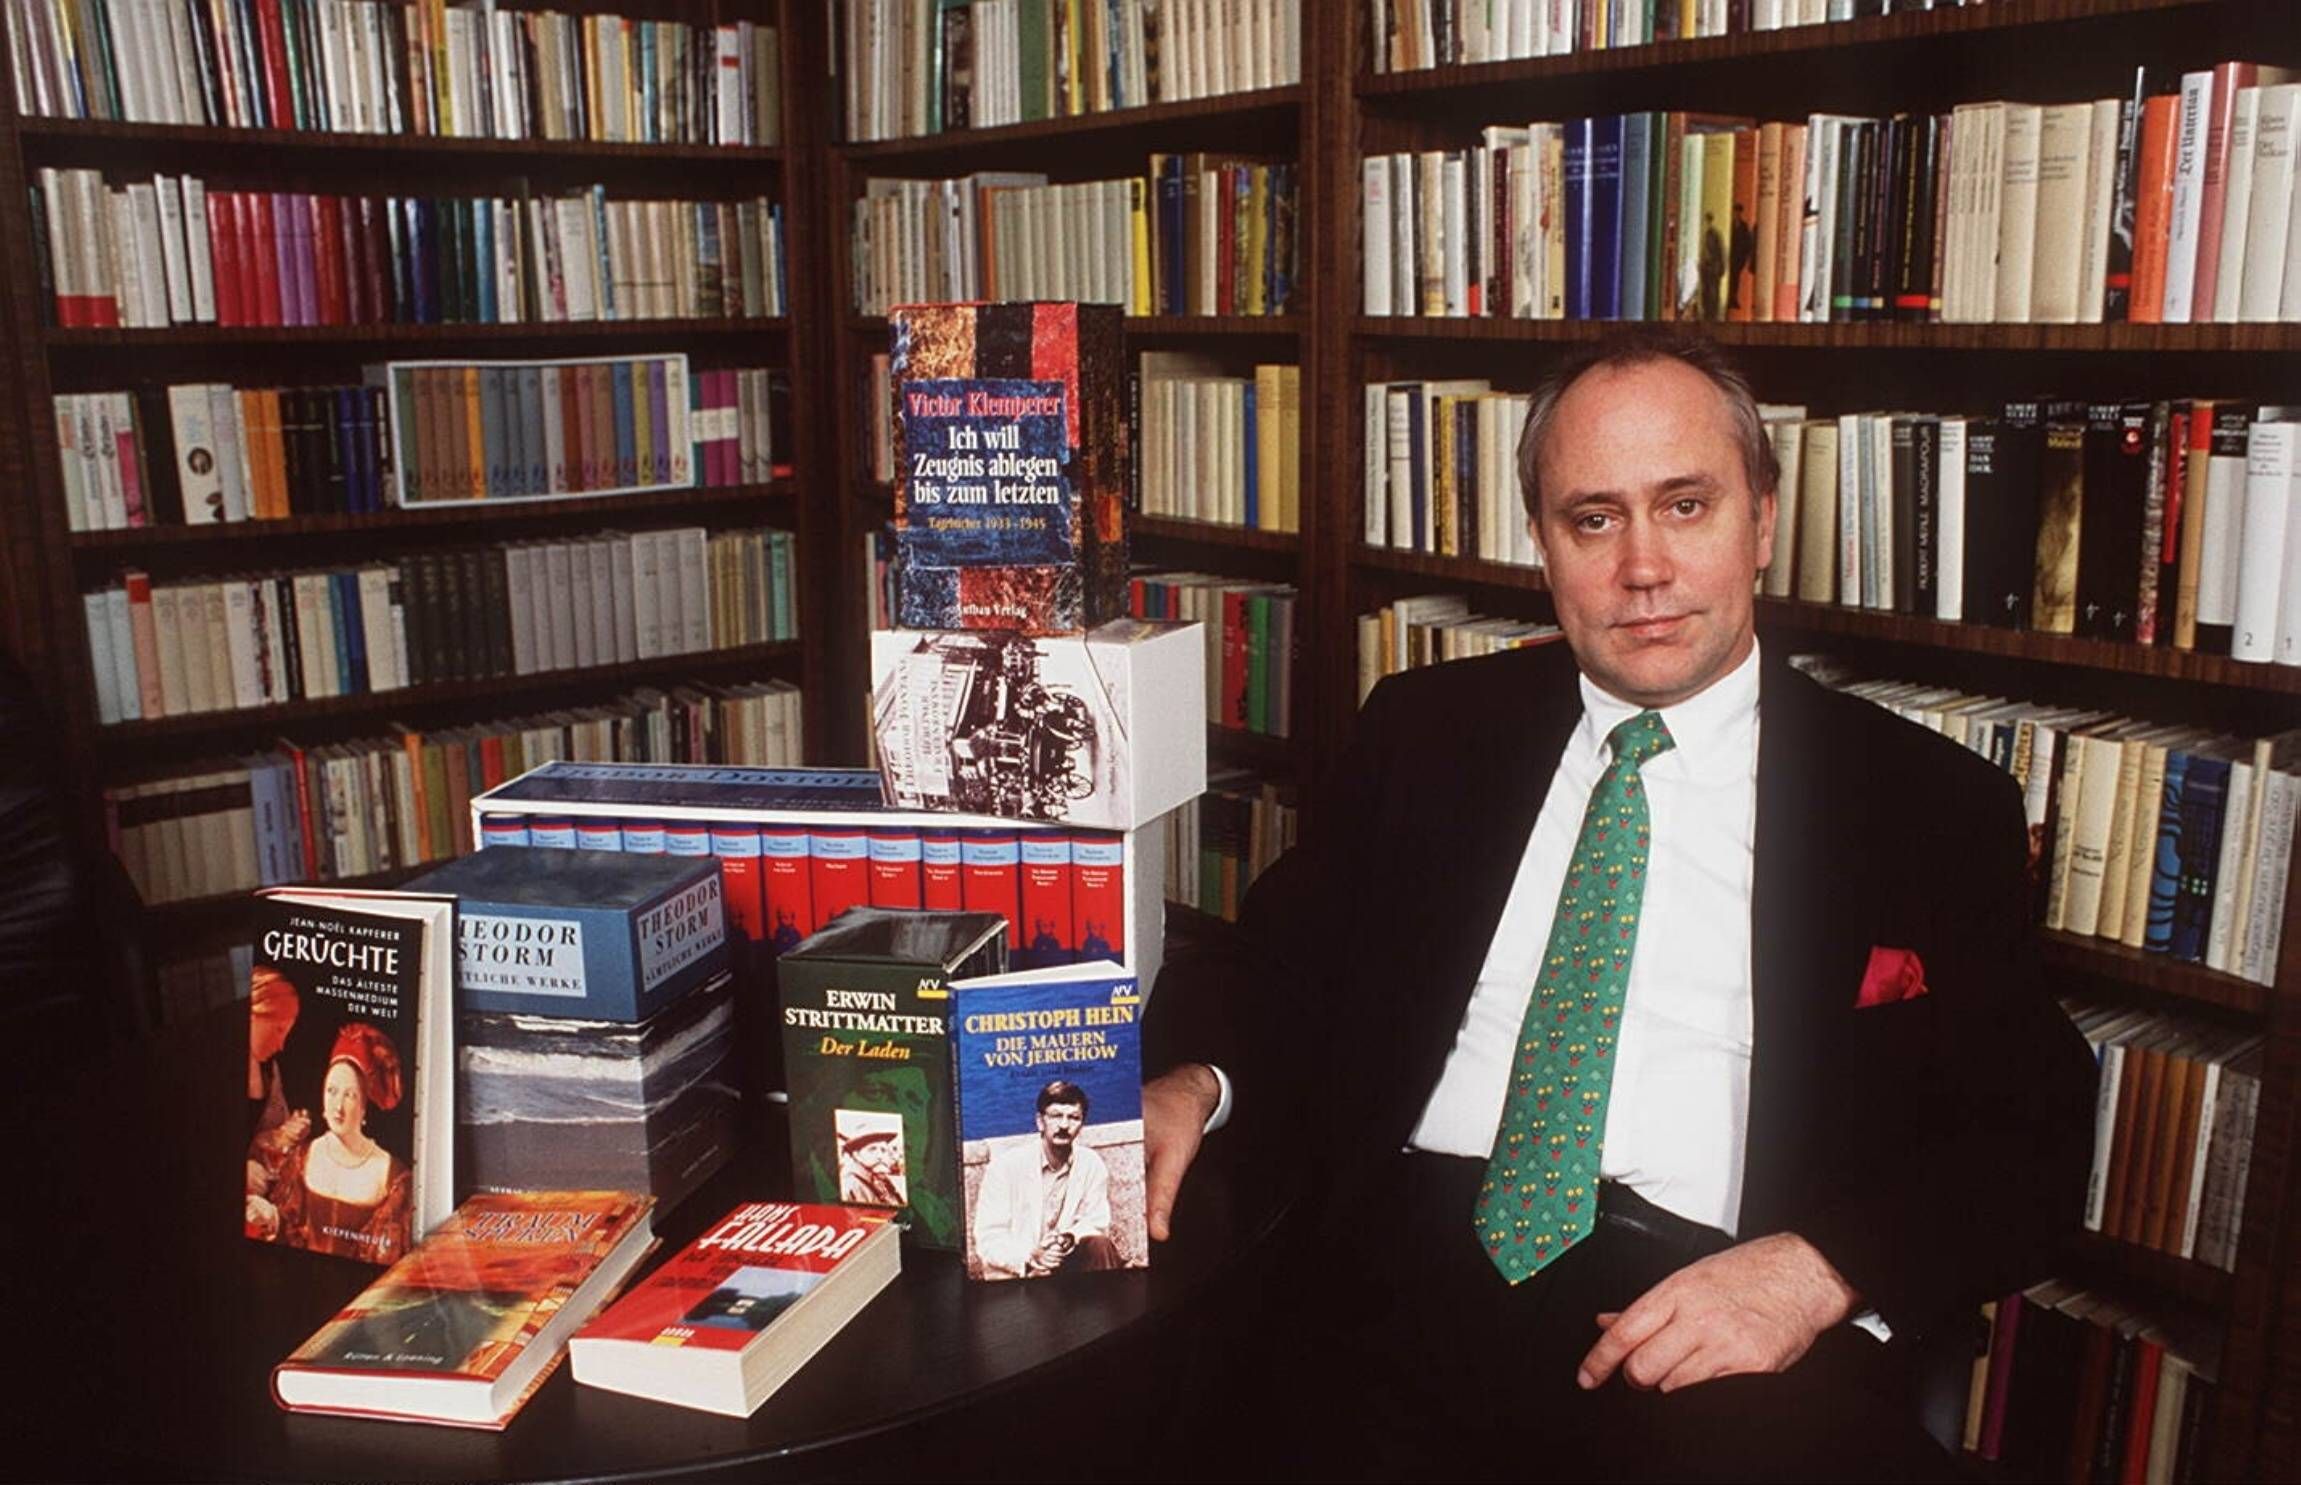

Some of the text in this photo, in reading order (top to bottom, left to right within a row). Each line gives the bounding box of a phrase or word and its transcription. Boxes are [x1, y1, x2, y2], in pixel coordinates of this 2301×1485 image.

[908, 391, 1061, 422] Victor Klemperer
[948, 425, 1020, 449] Ich will
[913, 453, 1058, 482] Zeugnis ablegen
[914, 480, 1060, 504] bis zum letzten
[706, 771, 879, 786] DOSTOJE
[640, 878, 720, 941] THEODOR
[349, 926, 400, 941] KAPFERER
[459, 920, 577, 946] EODOR
[655, 907, 709, 955] STORM
[332, 975, 398, 994] DAS ÄLTESTE
[527, 976, 583, 990] WERKE
[315, 985, 398, 1006] MASSENMEDIUM
[825, 989, 896, 1011] ERWIN
[348, 1004, 398, 1019] DER WELT
[785, 1007, 945, 1035] STRITTMATTER
[965, 1006, 1134, 1034] CHRISTOPH HEIN
[820, 1036, 911, 1060] Der Laden
[996, 1031, 1106, 1052] DIE MAUERN
[984, 1045, 1118, 1068] VON JERICHOW
[698, 1221, 867, 1259] FALLADA
